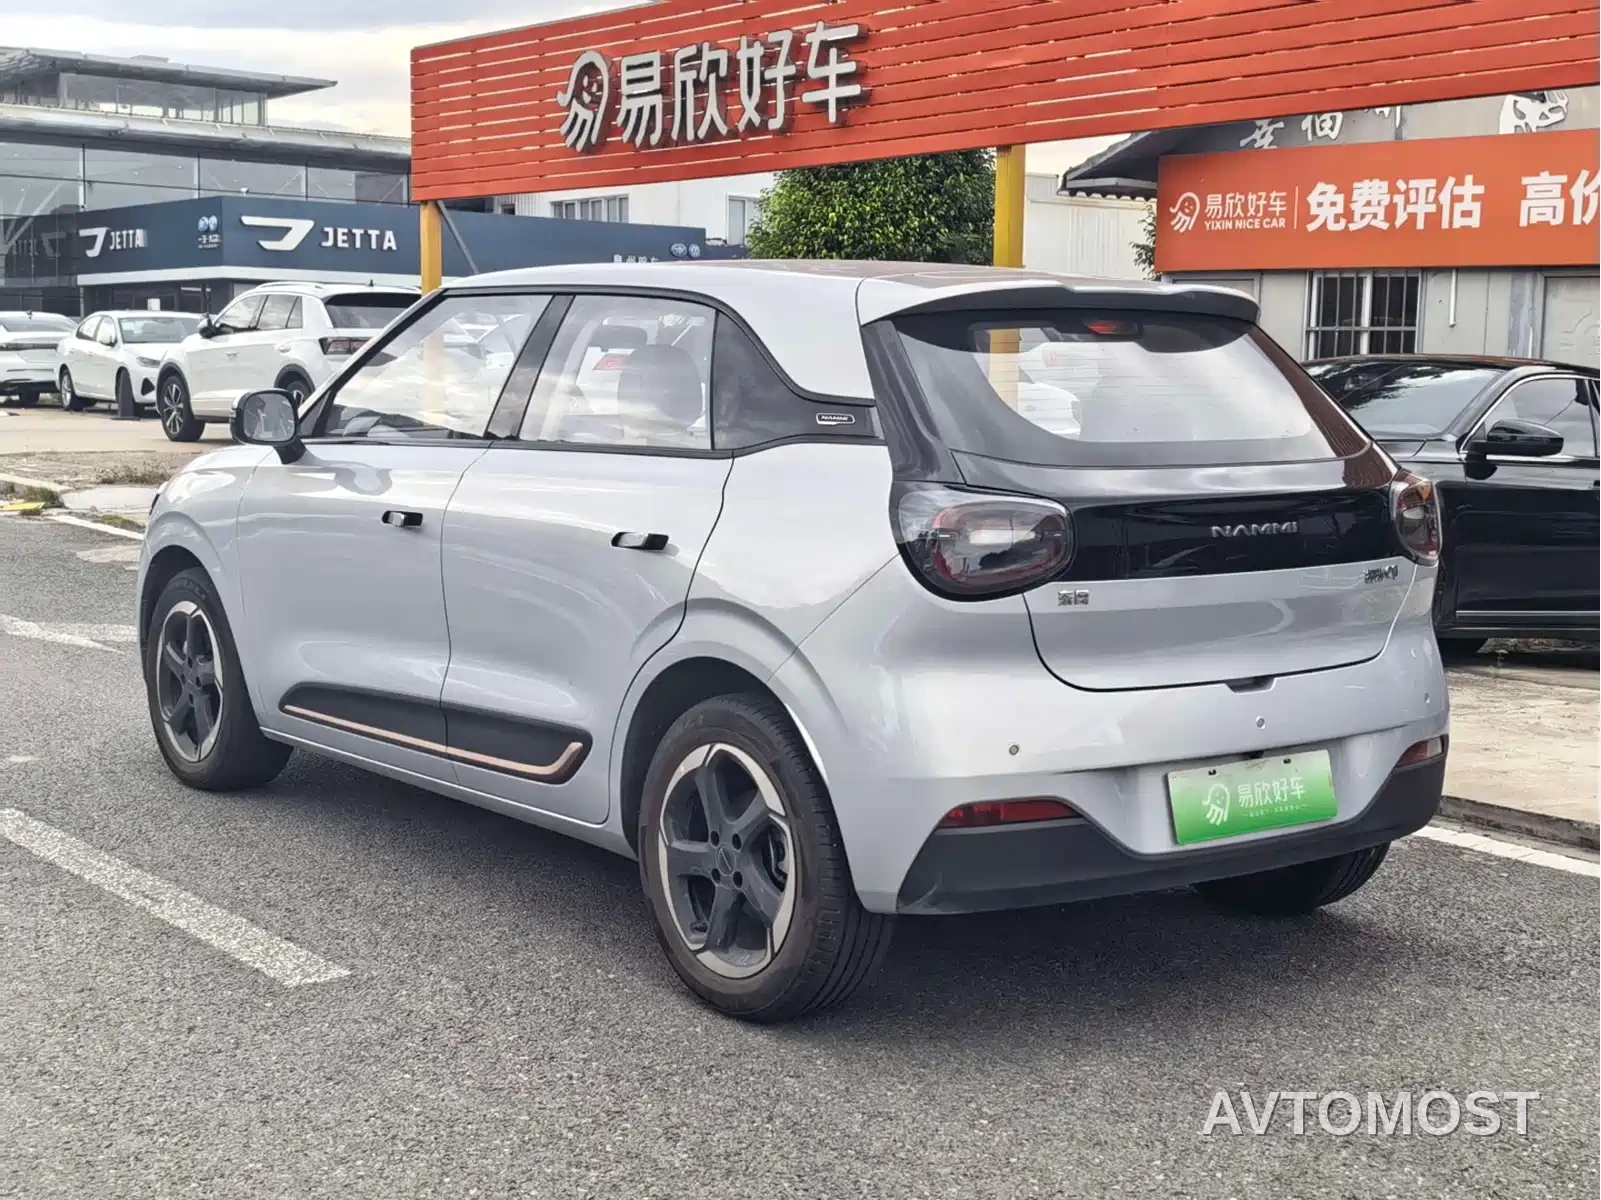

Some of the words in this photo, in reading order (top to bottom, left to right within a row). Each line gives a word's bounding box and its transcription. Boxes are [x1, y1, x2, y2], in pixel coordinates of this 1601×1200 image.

[617, 20, 862, 148] 易欣好车
[1205, 190, 1287, 219] 易欣好车
[1306, 175, 1485, 232] 免费评估
[1204, 220, 1233, 231] YIXIN
[1235, 218, 1261, 229] NICE
[1263, 217, 1286, 228] CAR
[109, 229, 146, 250] JETTA
[321, 227, 397, 250] JETTA
[1211, 521, 1298, 538] NAMMI
[1238, 776, 1306, 808] 易欣好车
